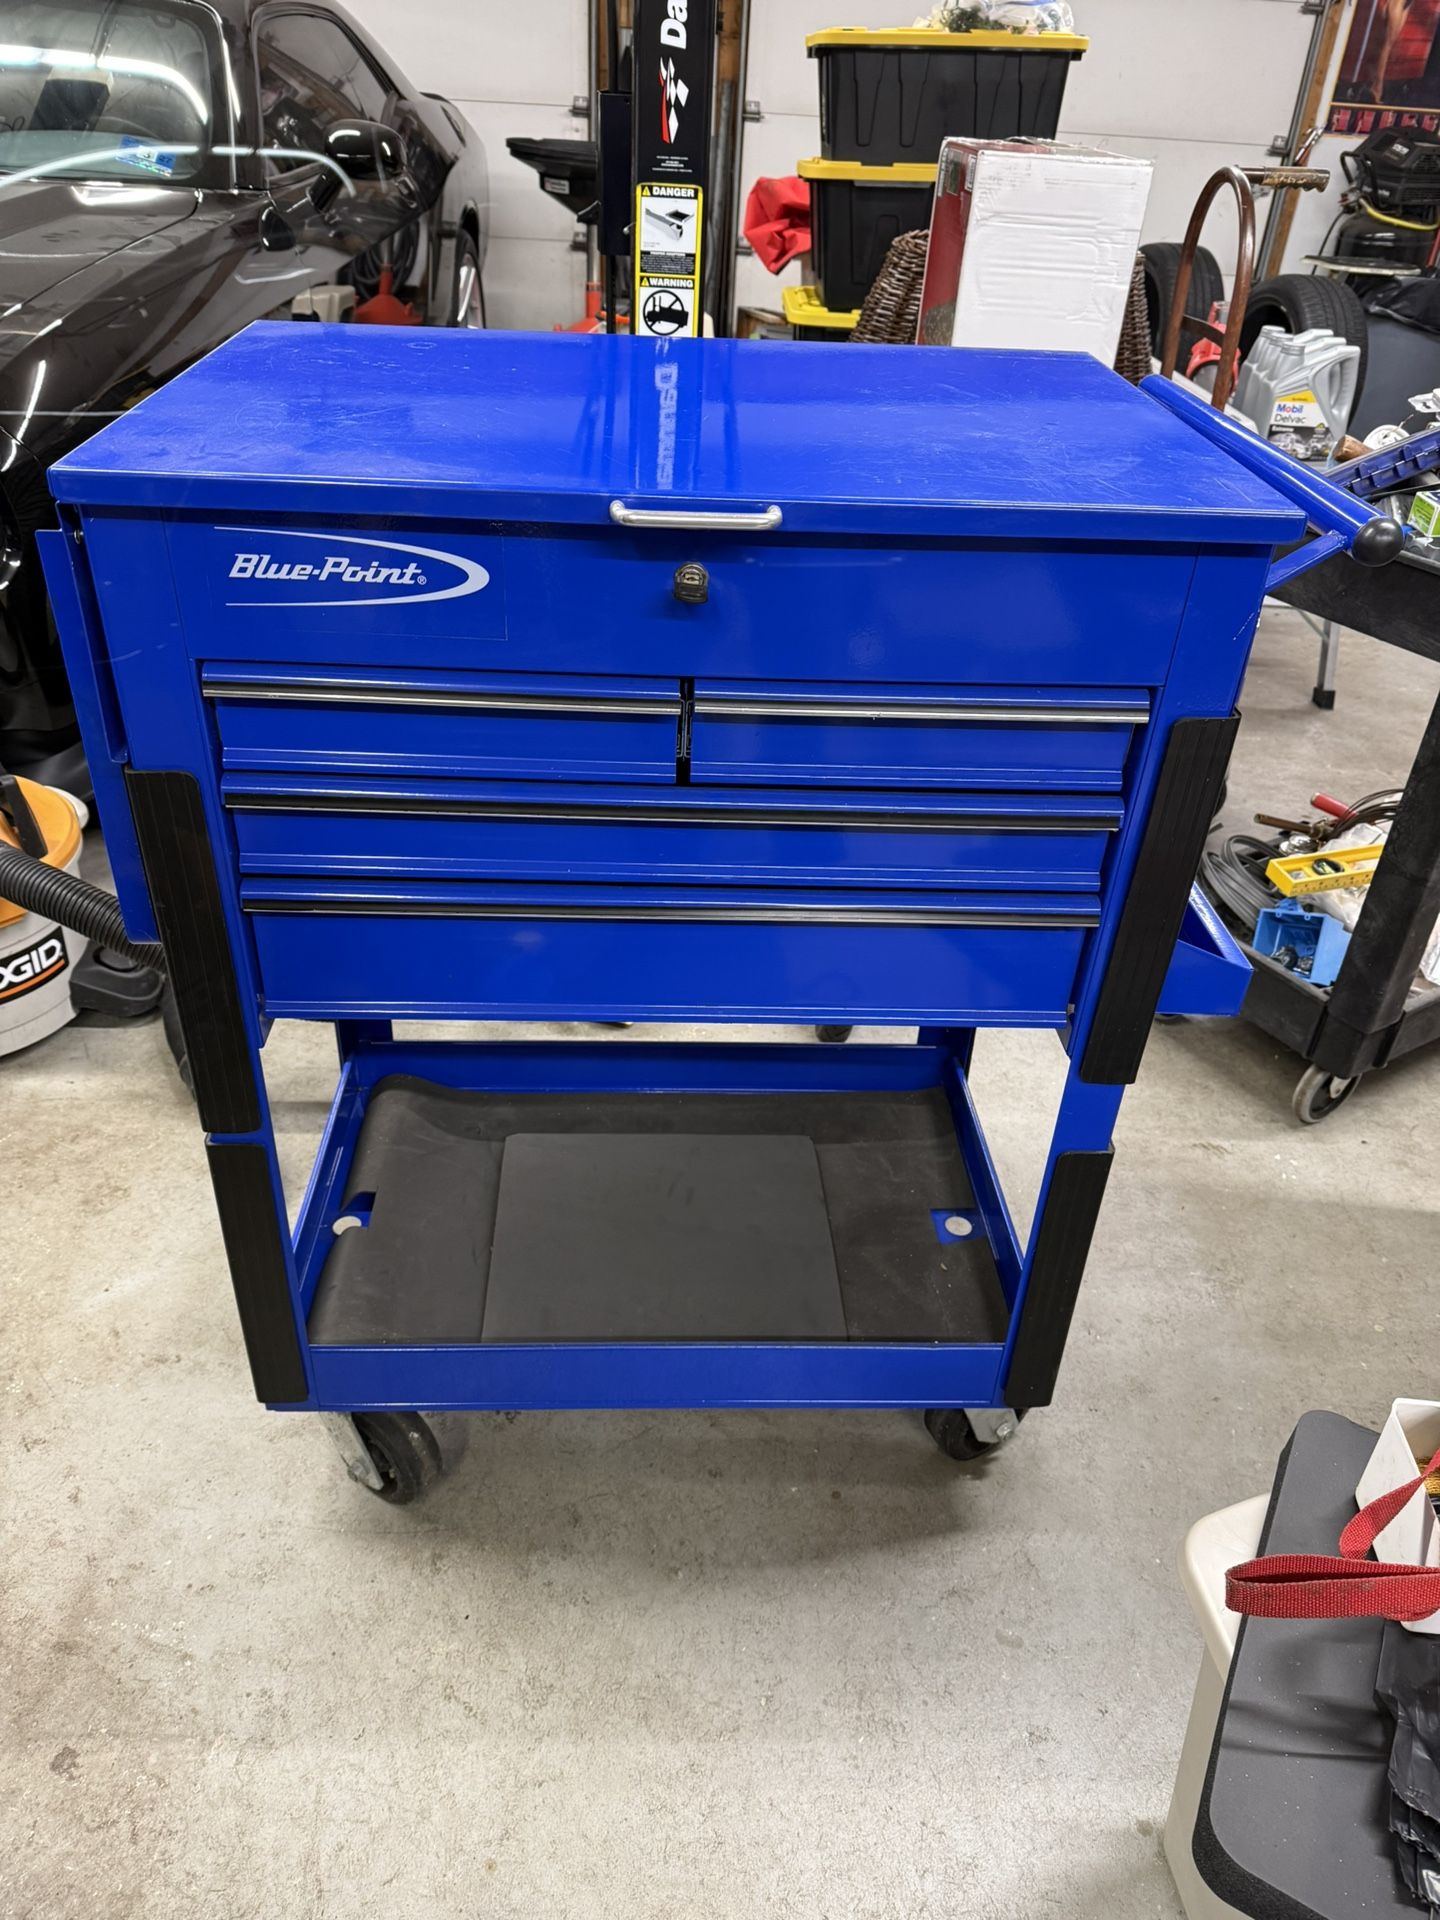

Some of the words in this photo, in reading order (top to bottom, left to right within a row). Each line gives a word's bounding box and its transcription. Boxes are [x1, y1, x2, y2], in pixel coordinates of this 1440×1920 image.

[652, 186, 695, 198] DANGER
[649, 277, 694, 288] WARNING
[1276, 404, 1304, 413] Mobil
[1274, 413, 1307, 424] Delvac
